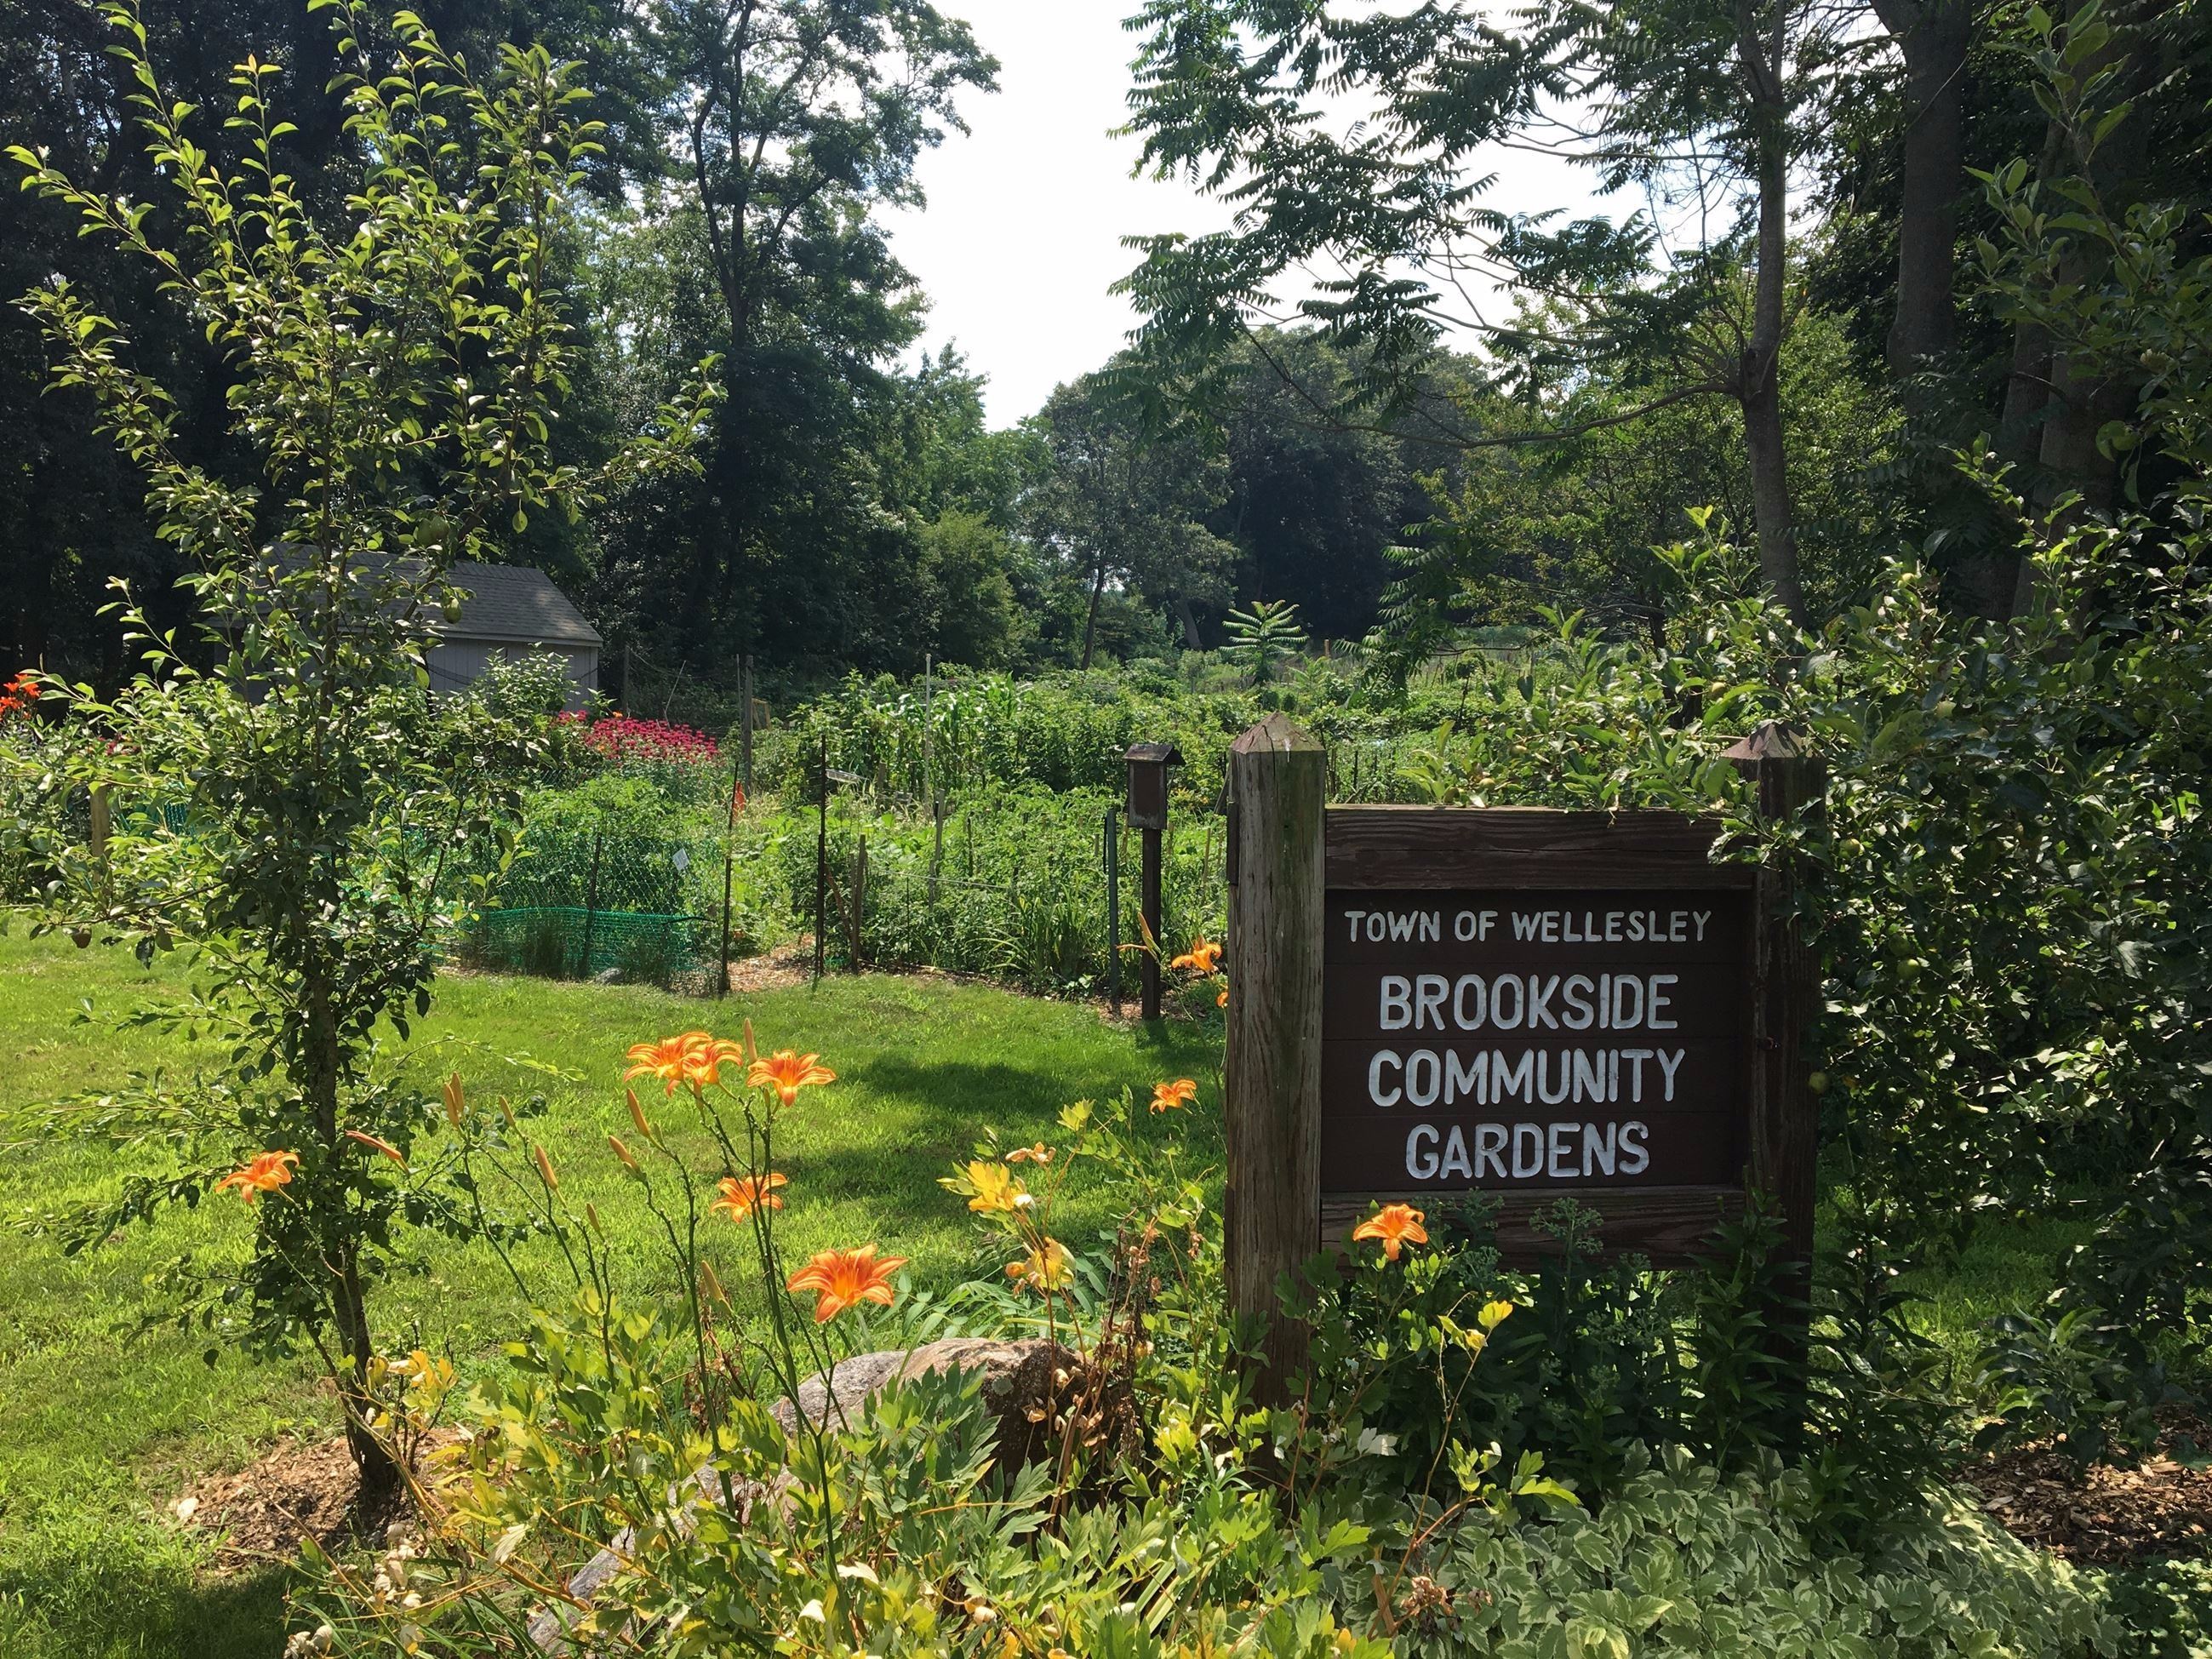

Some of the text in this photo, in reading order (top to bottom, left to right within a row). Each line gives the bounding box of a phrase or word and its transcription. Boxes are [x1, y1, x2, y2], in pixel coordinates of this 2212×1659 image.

[1344, 909, 1712, 943] TOWN OF WELLESLEY
[1379, 973, 1679, 1031] BROOKSIDE
[1367, 1048, 1686, 1107] COMMUNITY
[1404, 1121, 1650, 1180] GARDENS
